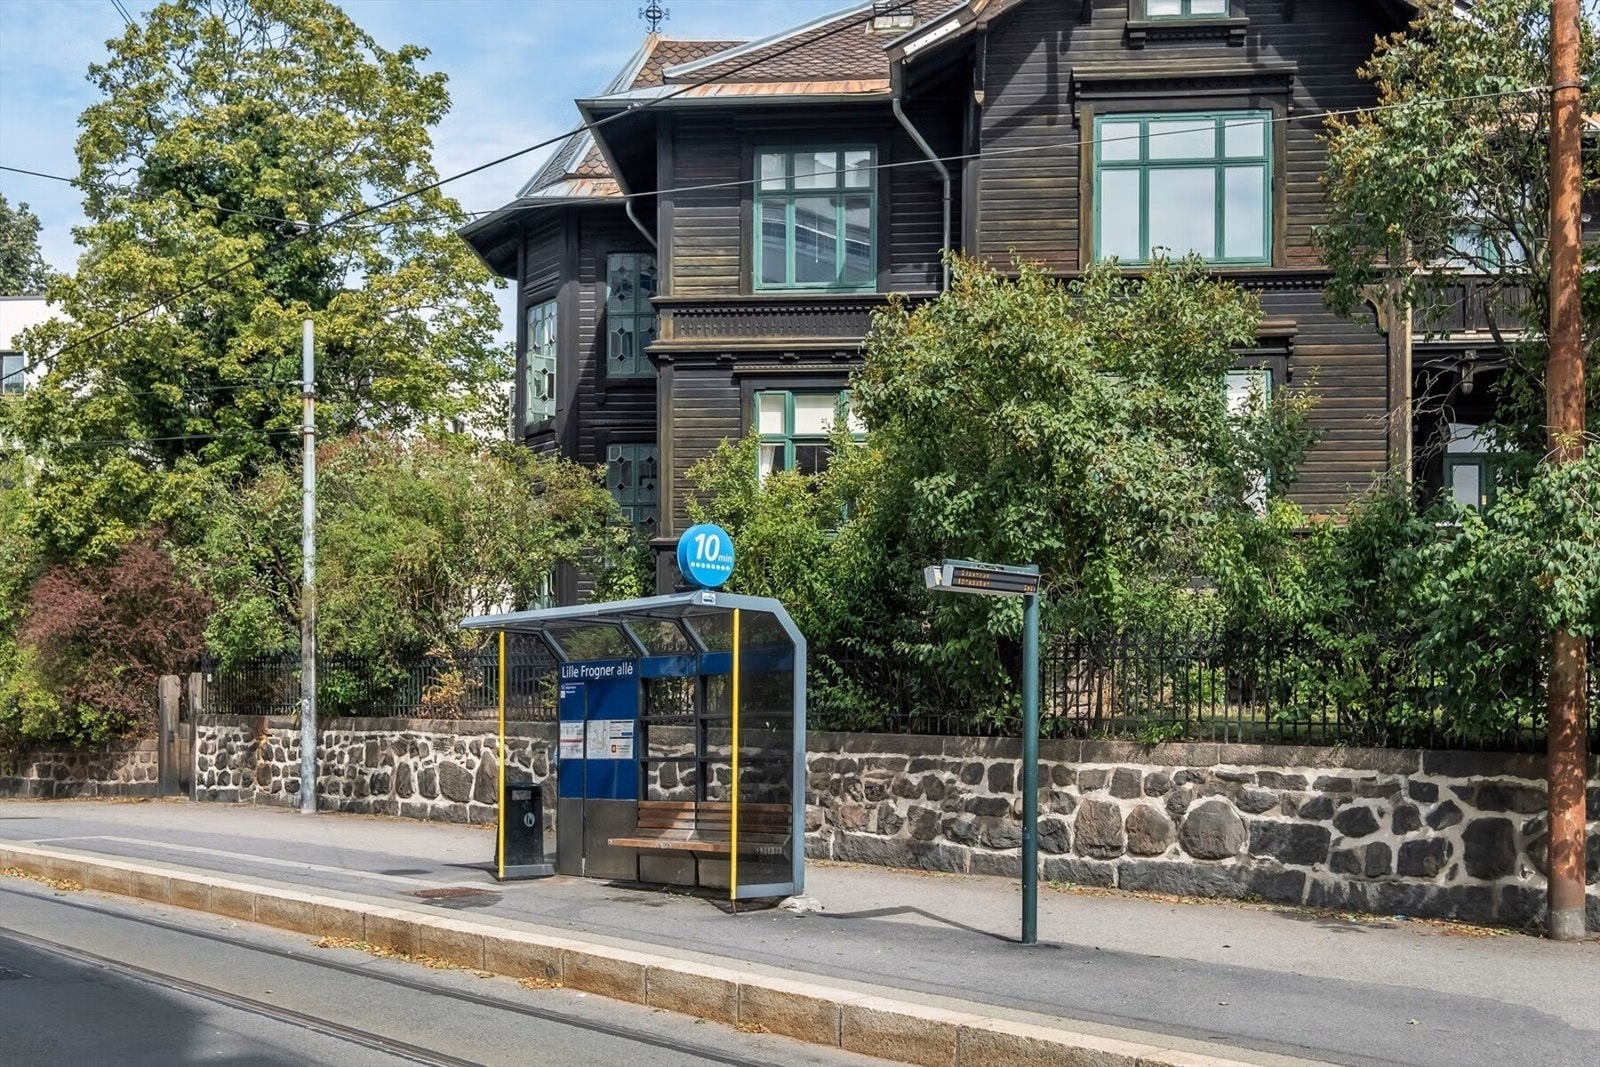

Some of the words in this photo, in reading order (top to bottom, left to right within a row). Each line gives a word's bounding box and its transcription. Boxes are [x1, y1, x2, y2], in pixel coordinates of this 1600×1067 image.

[695, 533, 720, 561] 10
[718, 553, 733, 563] min
[561, 665, 579, 678] Lille
[581, 665, 615, 680] Frogner
[616, 662, 633, 675] allé
